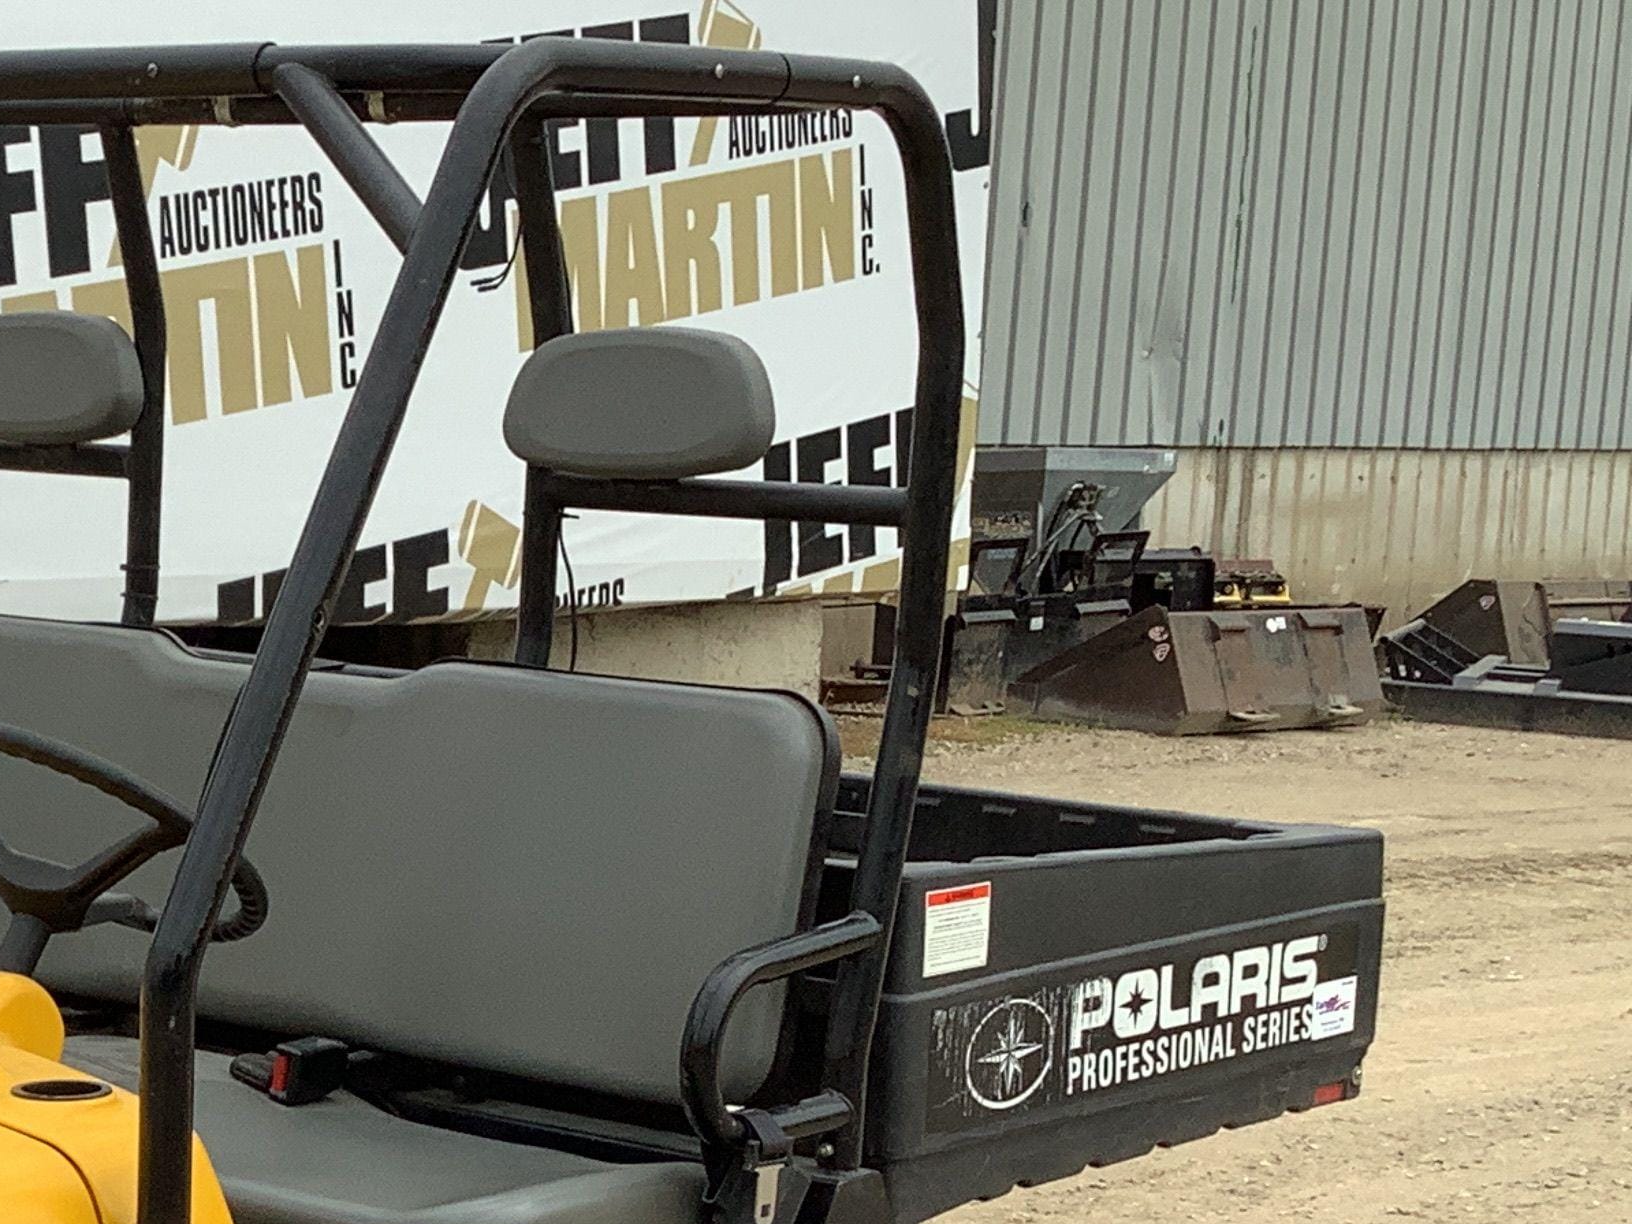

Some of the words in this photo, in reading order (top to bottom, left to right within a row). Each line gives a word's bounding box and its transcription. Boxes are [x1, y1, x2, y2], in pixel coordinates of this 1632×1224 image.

[160, 172, 325, 259] AUCTIONEERS
[725, 405, 916, 600] JEF
[1069, 934, 1320, 1051] POLARIS
[1065, 1021, 1237, 1096] PROFESSIONAL
[1241, 1003, 1314, 1054] SERIES
